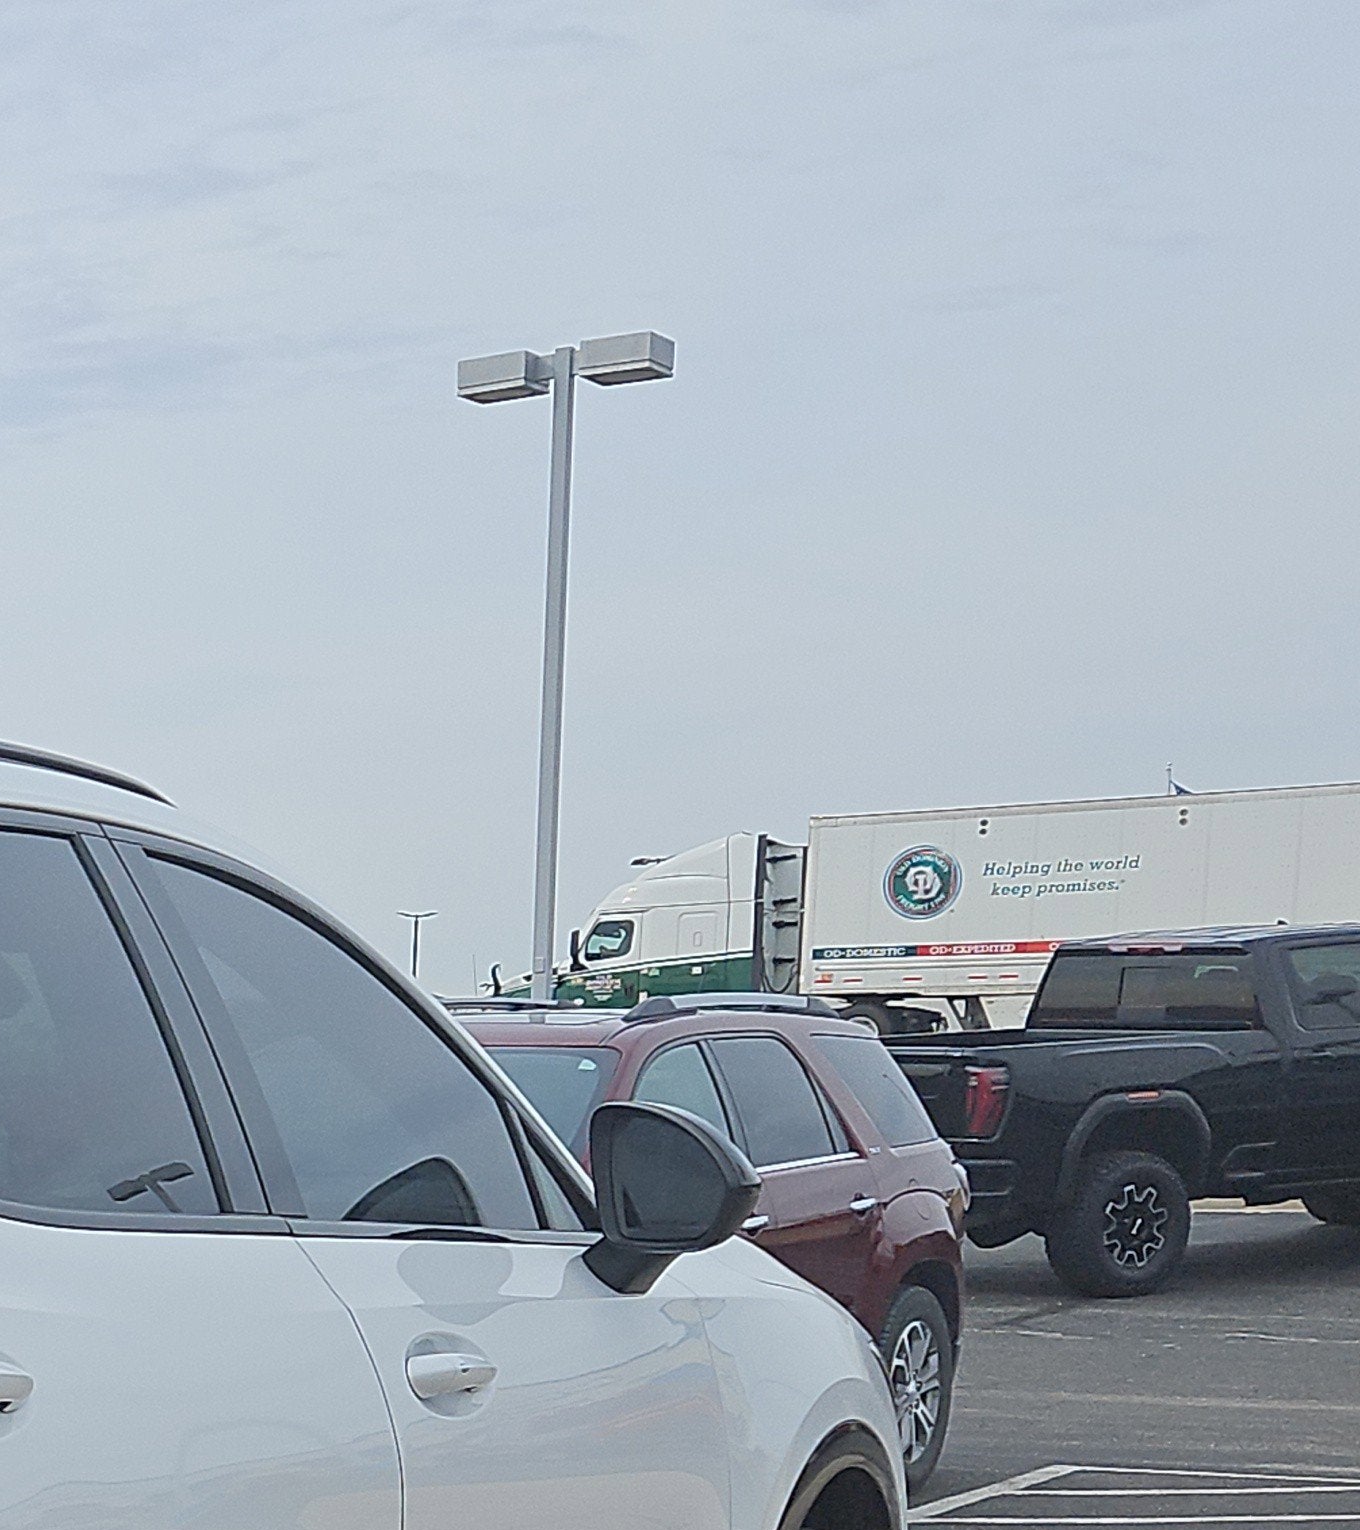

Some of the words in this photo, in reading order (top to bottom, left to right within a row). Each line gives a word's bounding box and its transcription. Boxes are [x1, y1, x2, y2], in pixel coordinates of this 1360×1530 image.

[982, 861, 1052, 878] Helping
[1056, 858, 1084, 873] the
[1089, 854, 1141, 871] world
[990, 882, 1033, 899] keep
